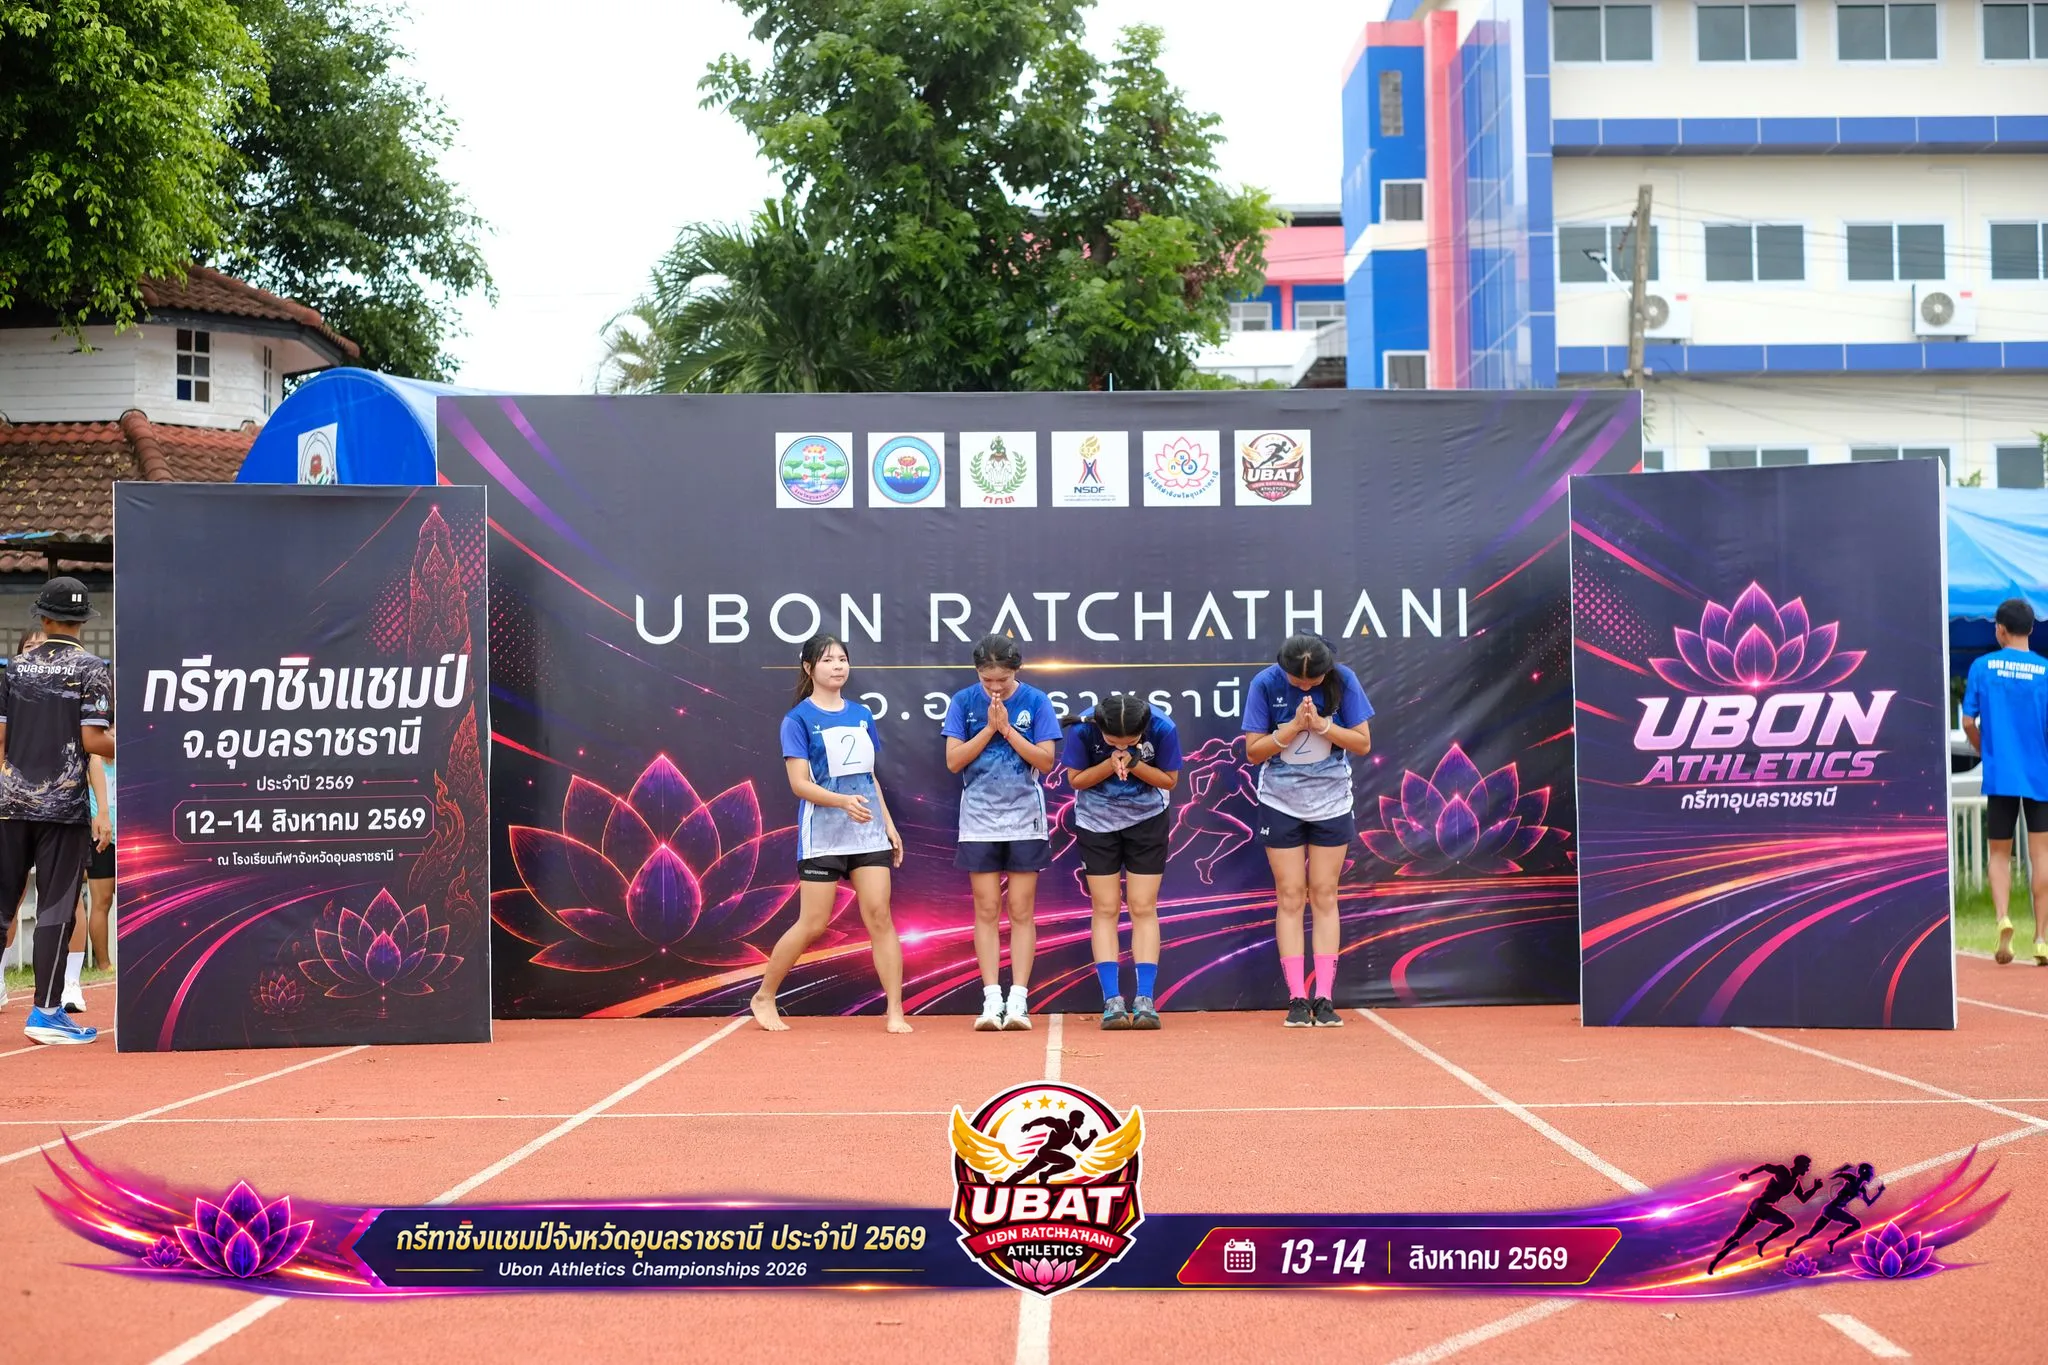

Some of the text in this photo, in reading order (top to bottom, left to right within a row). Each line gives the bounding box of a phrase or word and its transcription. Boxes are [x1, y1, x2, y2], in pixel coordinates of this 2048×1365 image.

[1247, 468, 1299, 482] UBAT
[1073, 486, 1105, 494] NSDF
[636, 588, 1468, 645] UBON RATCHATHANI
[16, 663, 75, 677] อุบลราชธานี
[143, 653, 468, 712] กรีฑาชิงแชมป์
[1634, 690, 1897, 751] UBON
[183, 715, 423, 769] จ.อุบลราชธานี
[840, 734, 862, 766] 2
[1294, 729, 1312, 755] 2
[1638, 751, 1887, 784] ATHLETICS
[256, 774, 354, 791] ประจำปี 2569
[1680, 785, 1838, 814] กรีฑาอุบลราชธานี
[271, 808, 360, 832] สิงหาคม
[367, 807, 426, 830] 2569
[217, 848, 394, 867] ณ โรงเรียนกีฬาจังหวัดอุบลราชธานี
